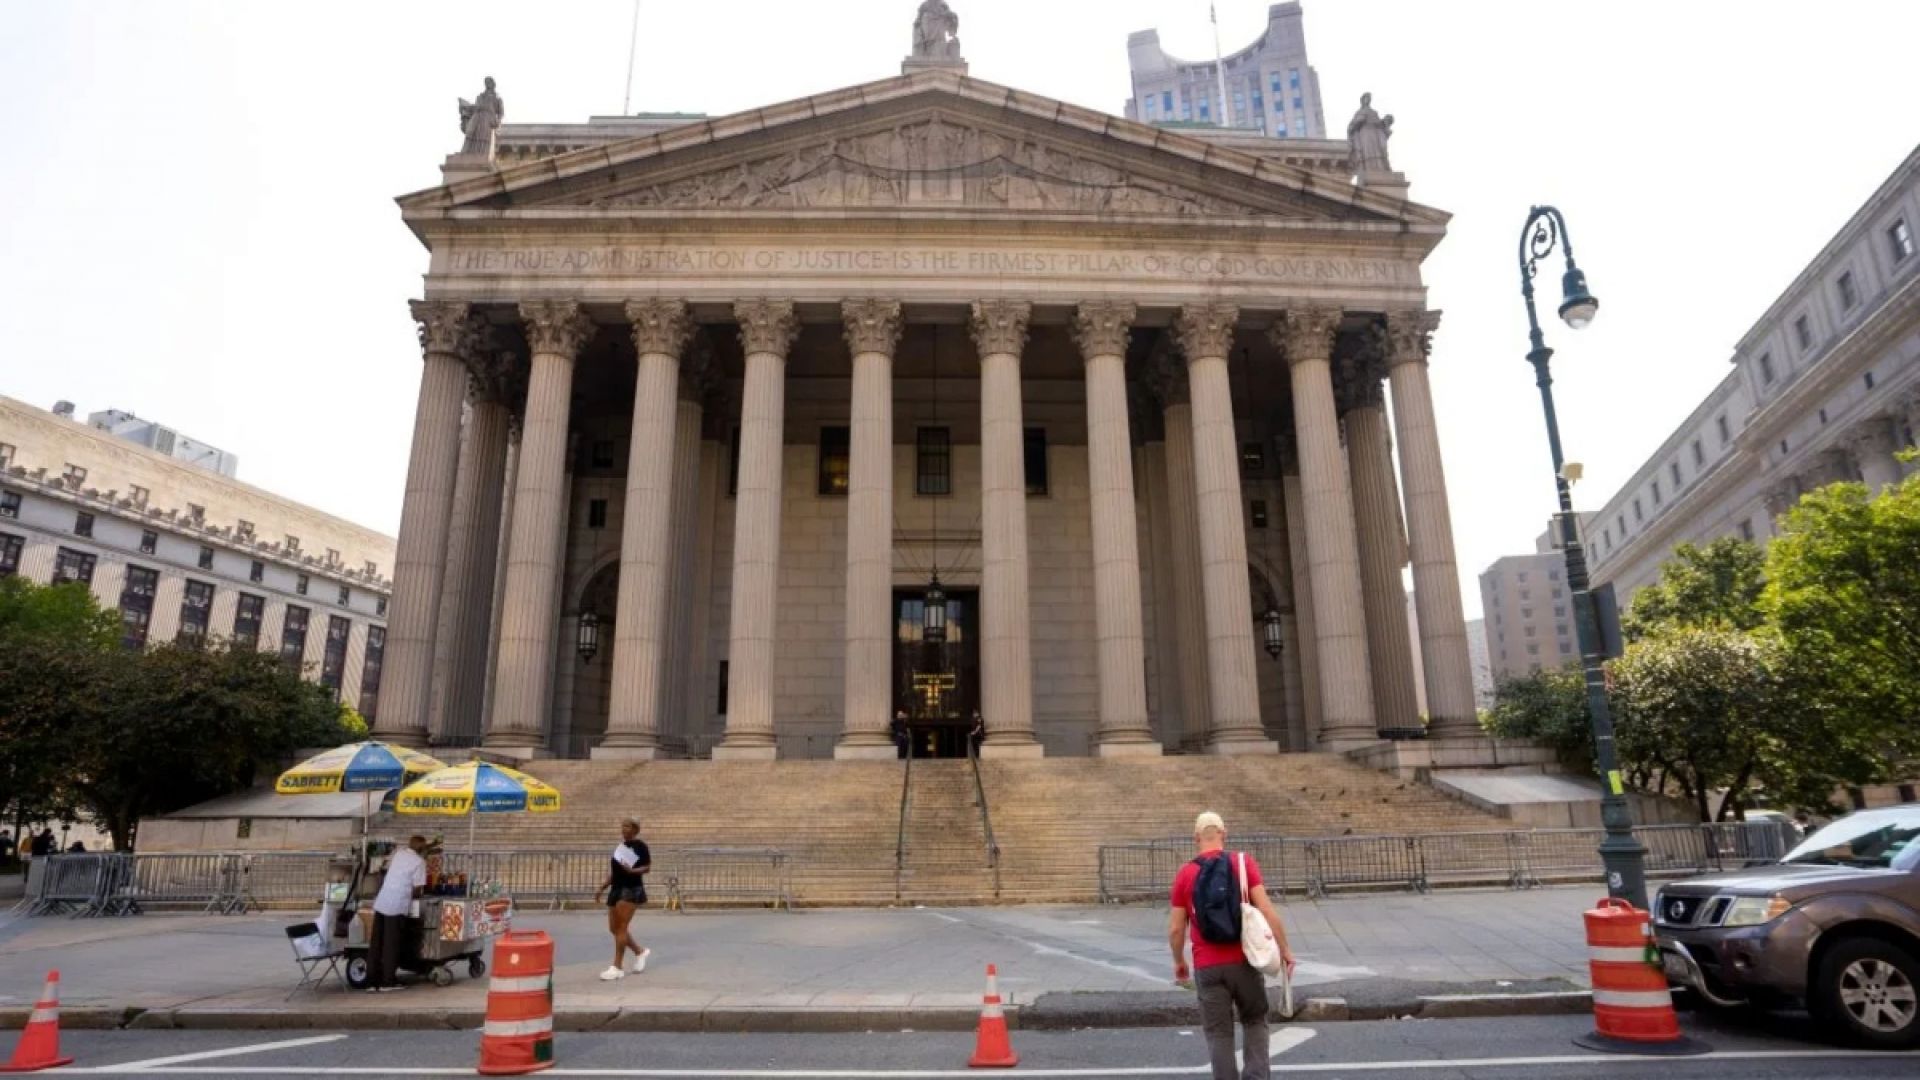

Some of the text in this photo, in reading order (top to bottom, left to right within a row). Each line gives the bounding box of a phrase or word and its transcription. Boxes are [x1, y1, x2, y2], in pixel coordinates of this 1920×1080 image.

[453, 250, 1401, 280] THE TRUE ADMINISTRATION OF JUSTICE IS THE FIRMEST PILLAR OF GOOD GOVERNMENT
[281, 774, 340, 788] SABRETT
[401, 796, 469, 809] SABRETT
